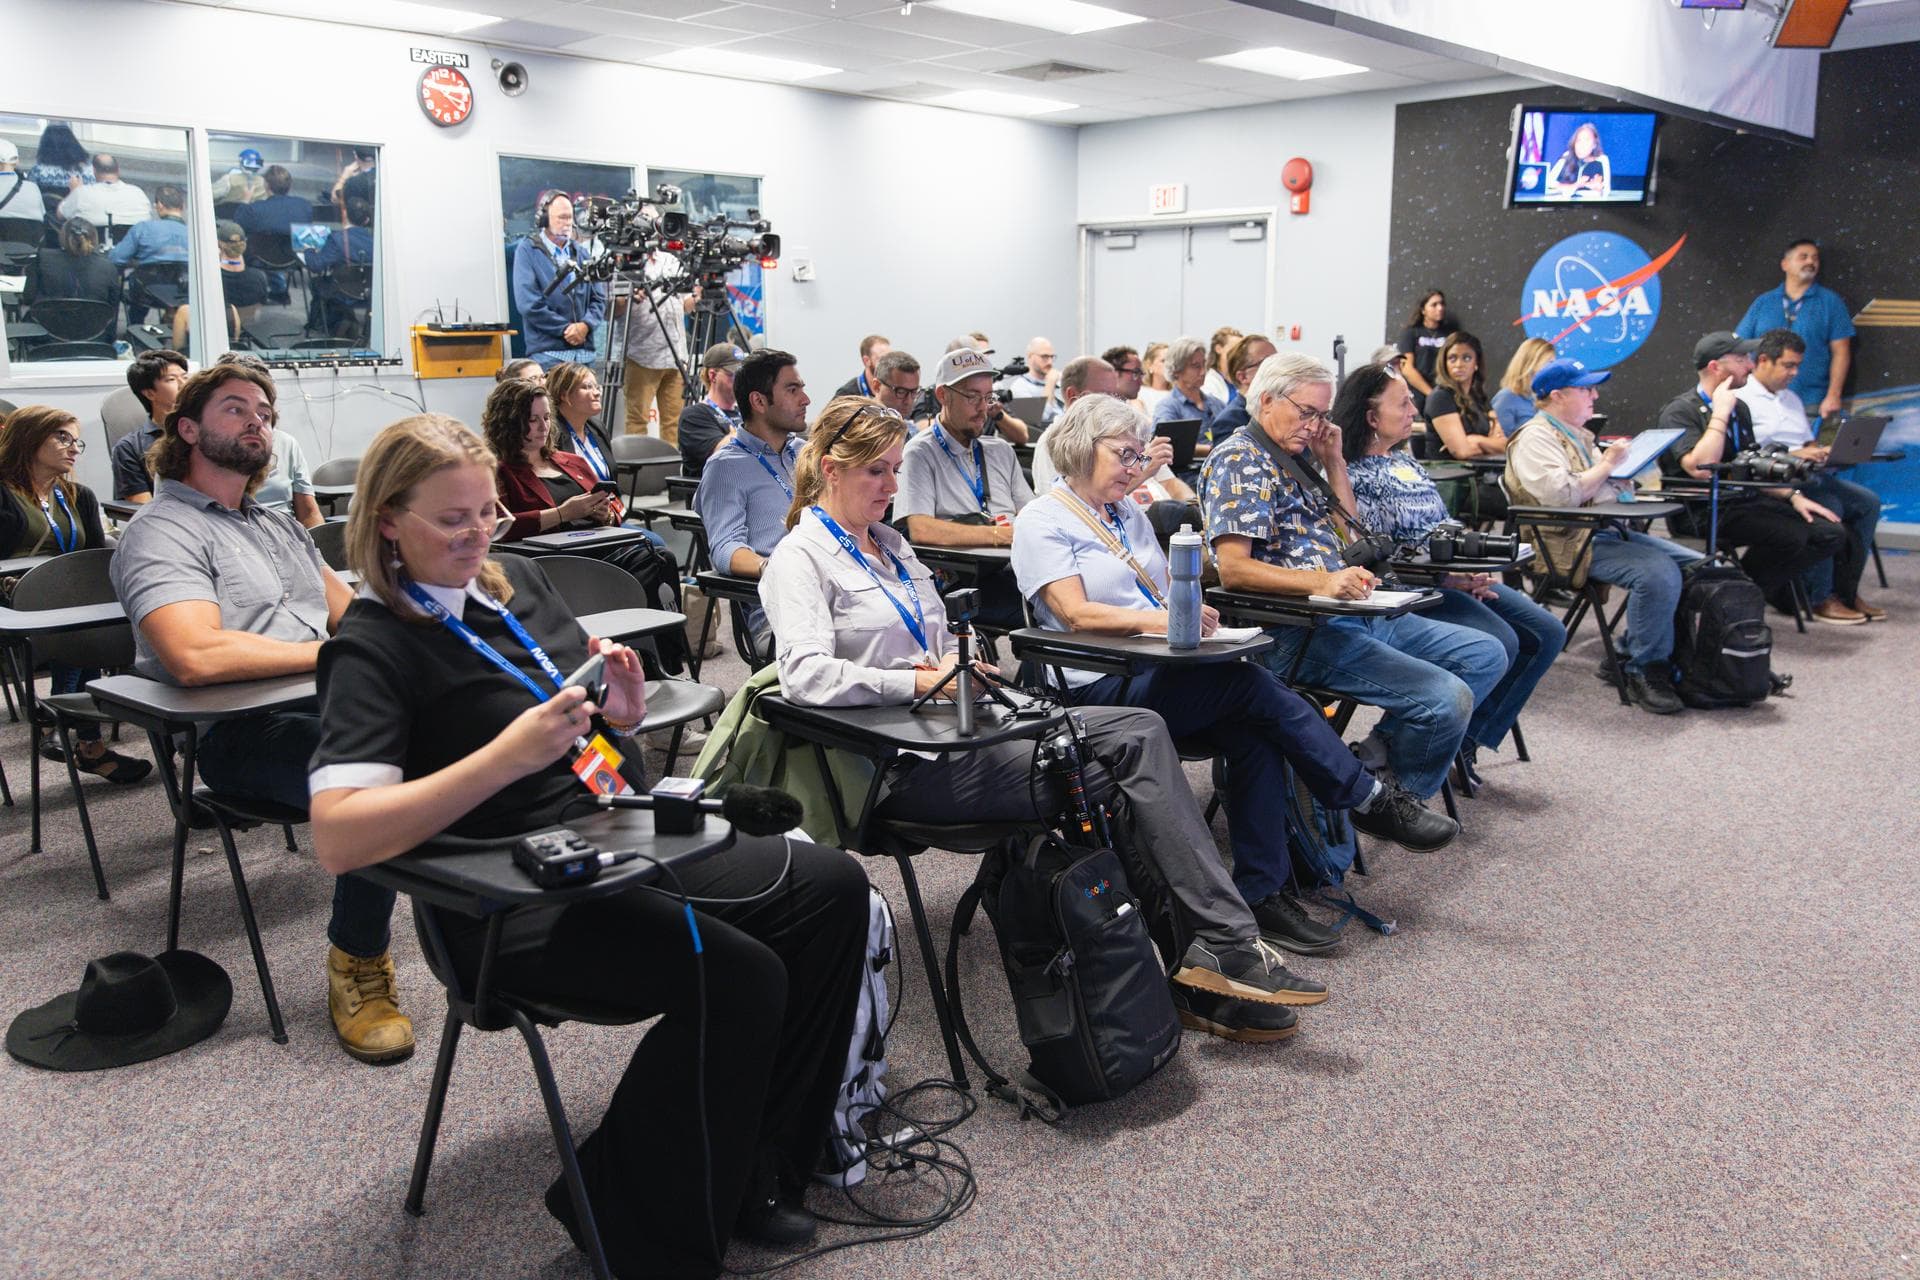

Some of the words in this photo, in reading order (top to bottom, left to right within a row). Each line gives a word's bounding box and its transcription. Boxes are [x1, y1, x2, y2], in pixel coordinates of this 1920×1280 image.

[411, 49, 468, 67] EASTERN
[1155, 186, 1178, 208] EXIT
[1531, 285, 1653, 318] NASA
[952, 355, 963, 367] U
[838, 535, 856, 553] LSP
[903, 579, 918, 602] NASA
[424, 600, 451, 622] LSP
[530, 646, 559, 679] NASA
[1083, 879, 1111, 899] Google
